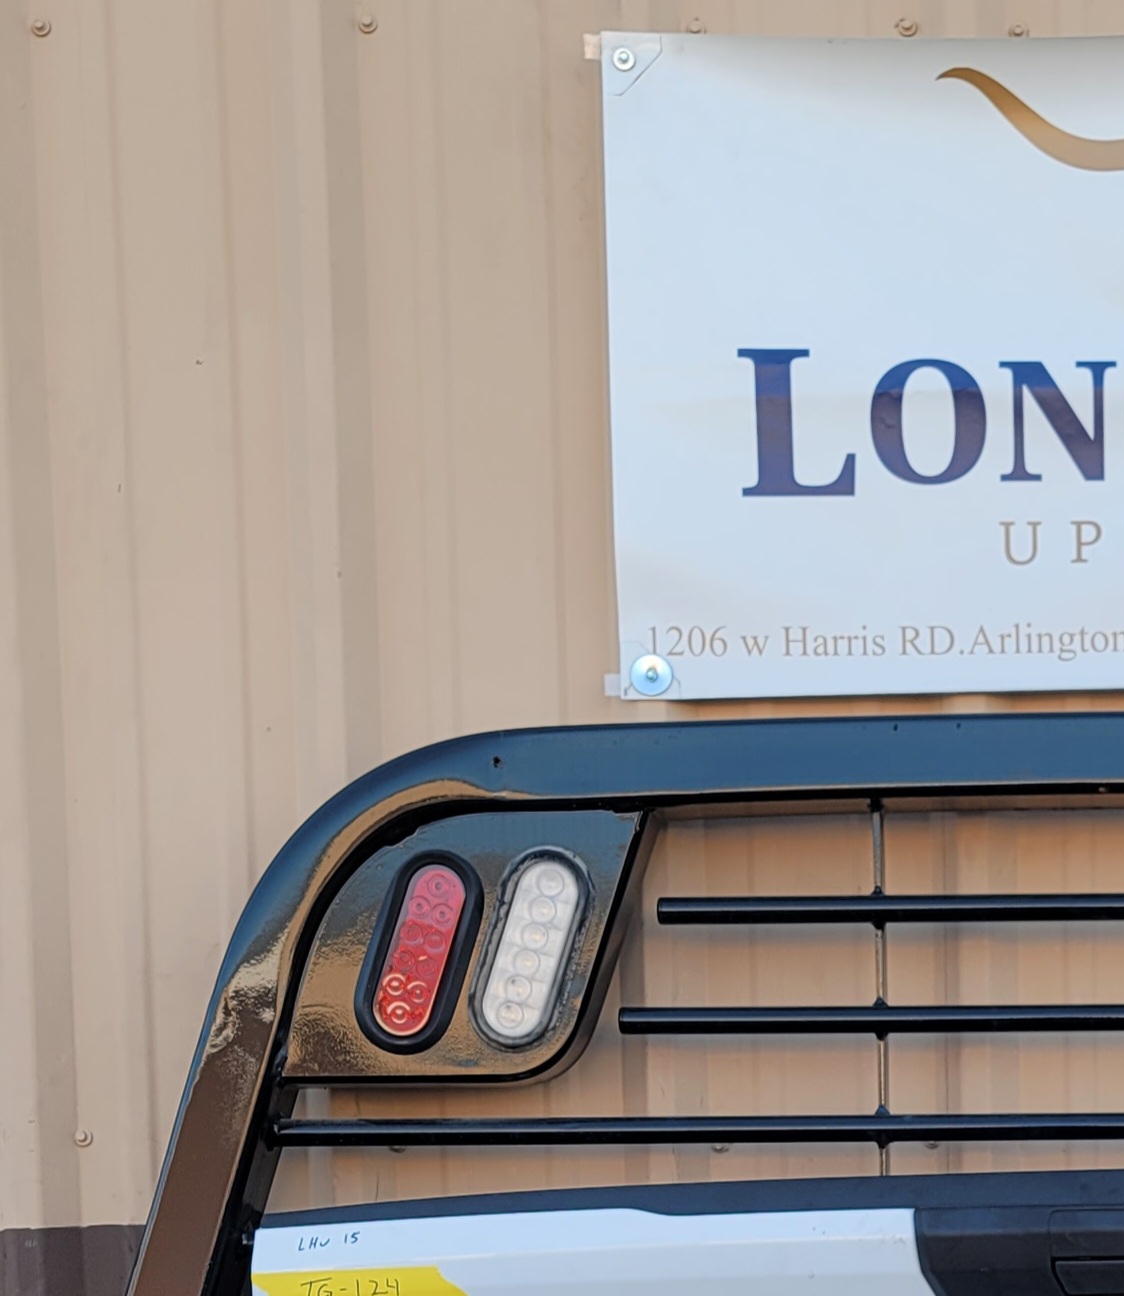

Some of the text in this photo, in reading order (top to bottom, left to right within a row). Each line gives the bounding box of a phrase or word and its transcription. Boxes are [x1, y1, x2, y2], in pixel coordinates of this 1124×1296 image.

[647, 625, 728, 657] 1206
[740, 635, 769, 656] w
[782, 625, 886, 657] Harris
[344, 1230, 361, 1245] 15
